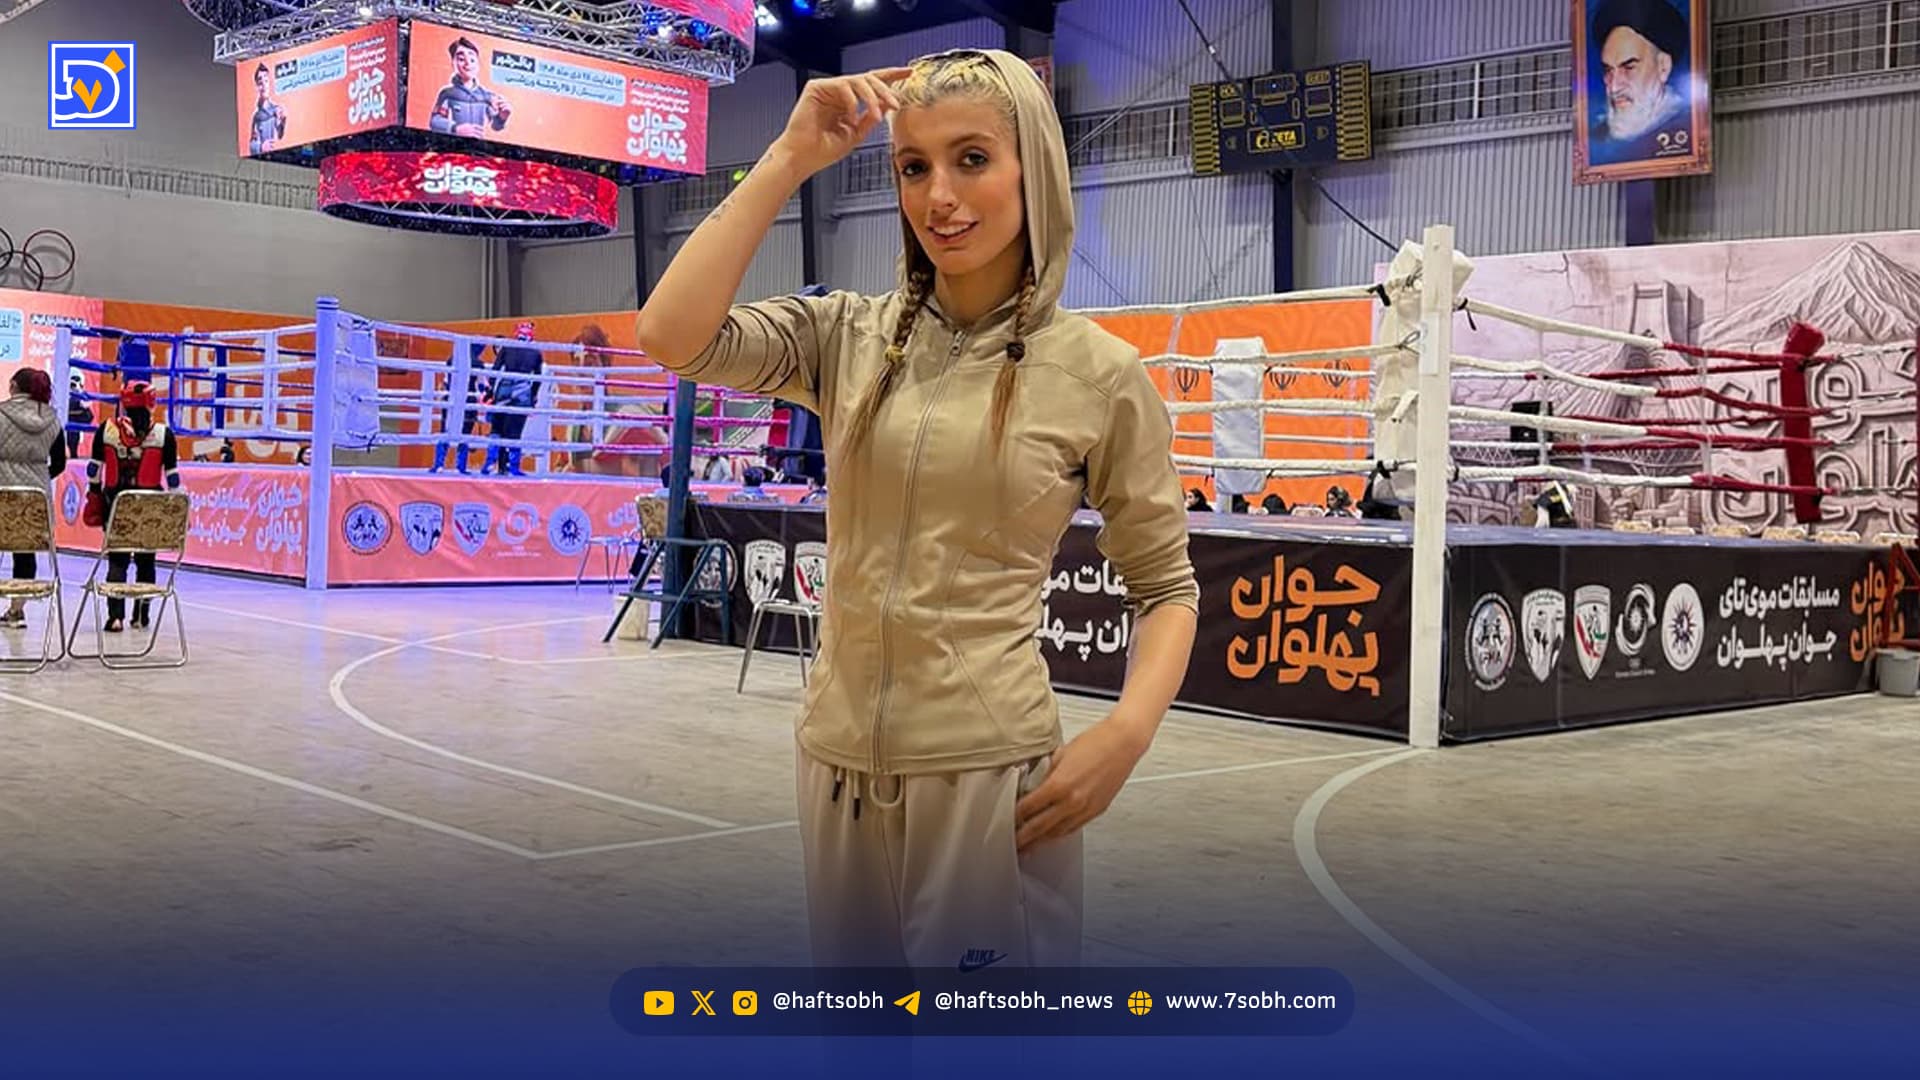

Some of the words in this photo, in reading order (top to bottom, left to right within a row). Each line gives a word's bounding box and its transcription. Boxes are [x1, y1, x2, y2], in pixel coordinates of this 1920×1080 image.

[626, 108, 687, 136] جوان
[625, 131, 688, 165] پهلوان
[1231, 555, 1381, 624] جوان
[1778, 575, 1840, 618] مسابقات
[1227, 610, 1381, 697] پهلوان
[1717, 623, 1789, 671] پهلوان
[1788, 621, 1838, 663] جوان
[966, 948, 995, 963] NIKE
